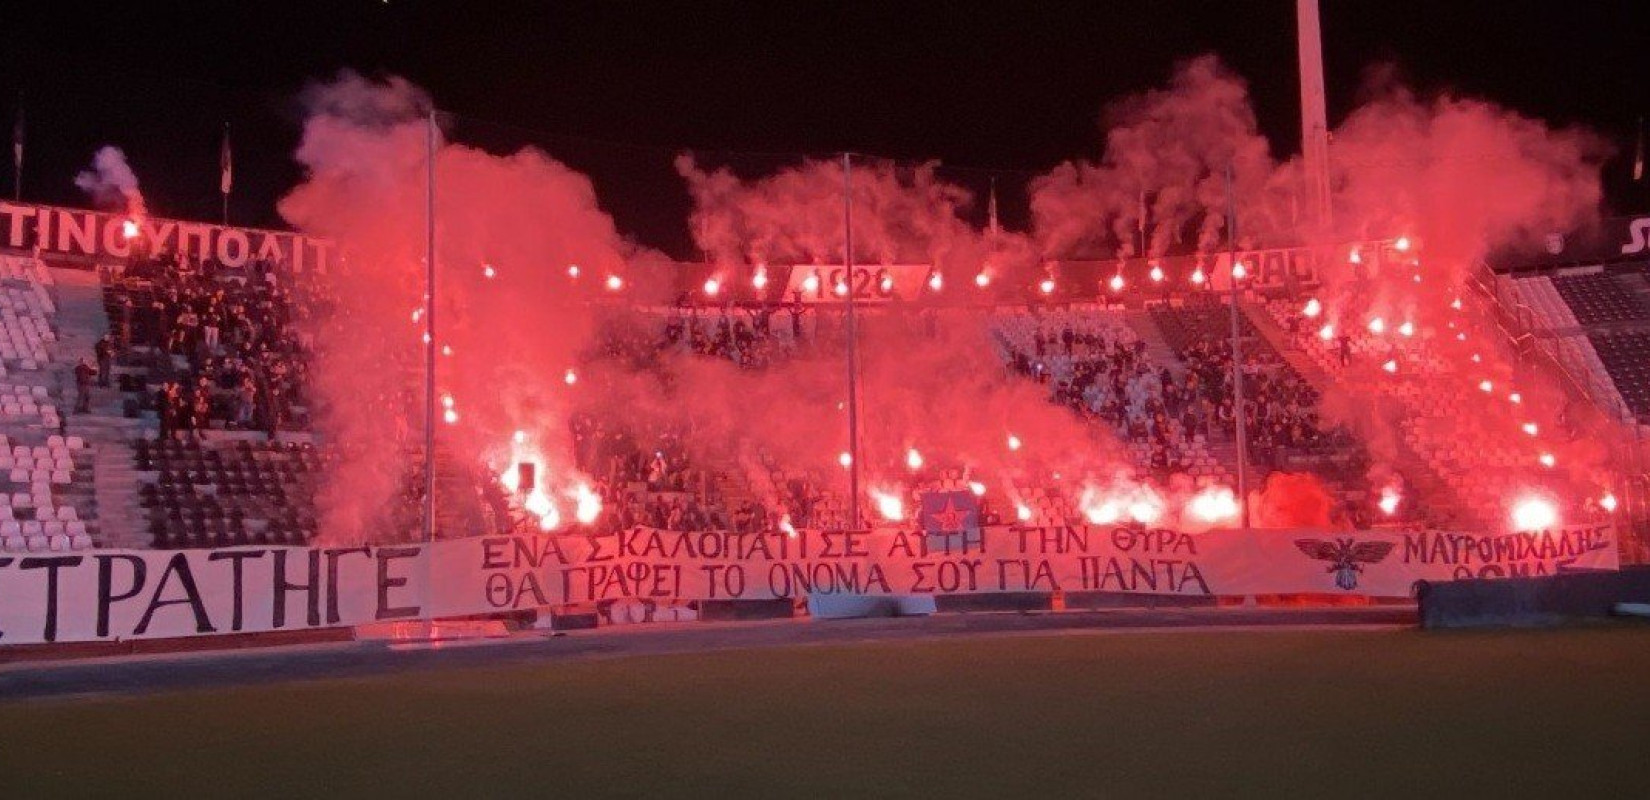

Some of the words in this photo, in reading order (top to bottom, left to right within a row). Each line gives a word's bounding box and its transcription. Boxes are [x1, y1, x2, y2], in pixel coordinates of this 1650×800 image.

[0, 203, 340, 274] ΤΙΝΟΥΠΟΛΙΤ
[481, 536, 570, 570] ΕΝΑ
[585, 527, 806, 561] ΣΚΑΛΟΠΑΤΙ
[818, 529, 872, 559] ΣΕ
[888, 526, 986, 558] ΑΥΤΗ
[1008, 524, 1089, 554] ΤΗΝ
[1110, 527, 1198, 555] ΘΥΡΑ
[0, 546, 421, 642] ΤΡΑΤΗΓΕ
[485, 571, 550, 609] ΘΑ
[559, 561, 682, 605] ΓΡΑΦΕΙ
[701, 564, 746, 599] ΤΟ
[768, 562, 892, 599] ΟΝΟΜΑ
[911, 560, 981, 594] ΣΟΥ
[996, 558, 1062, 591] ΓΙΑ
[1076, 555, 1211, 595] ΠΑΝΤΑ
